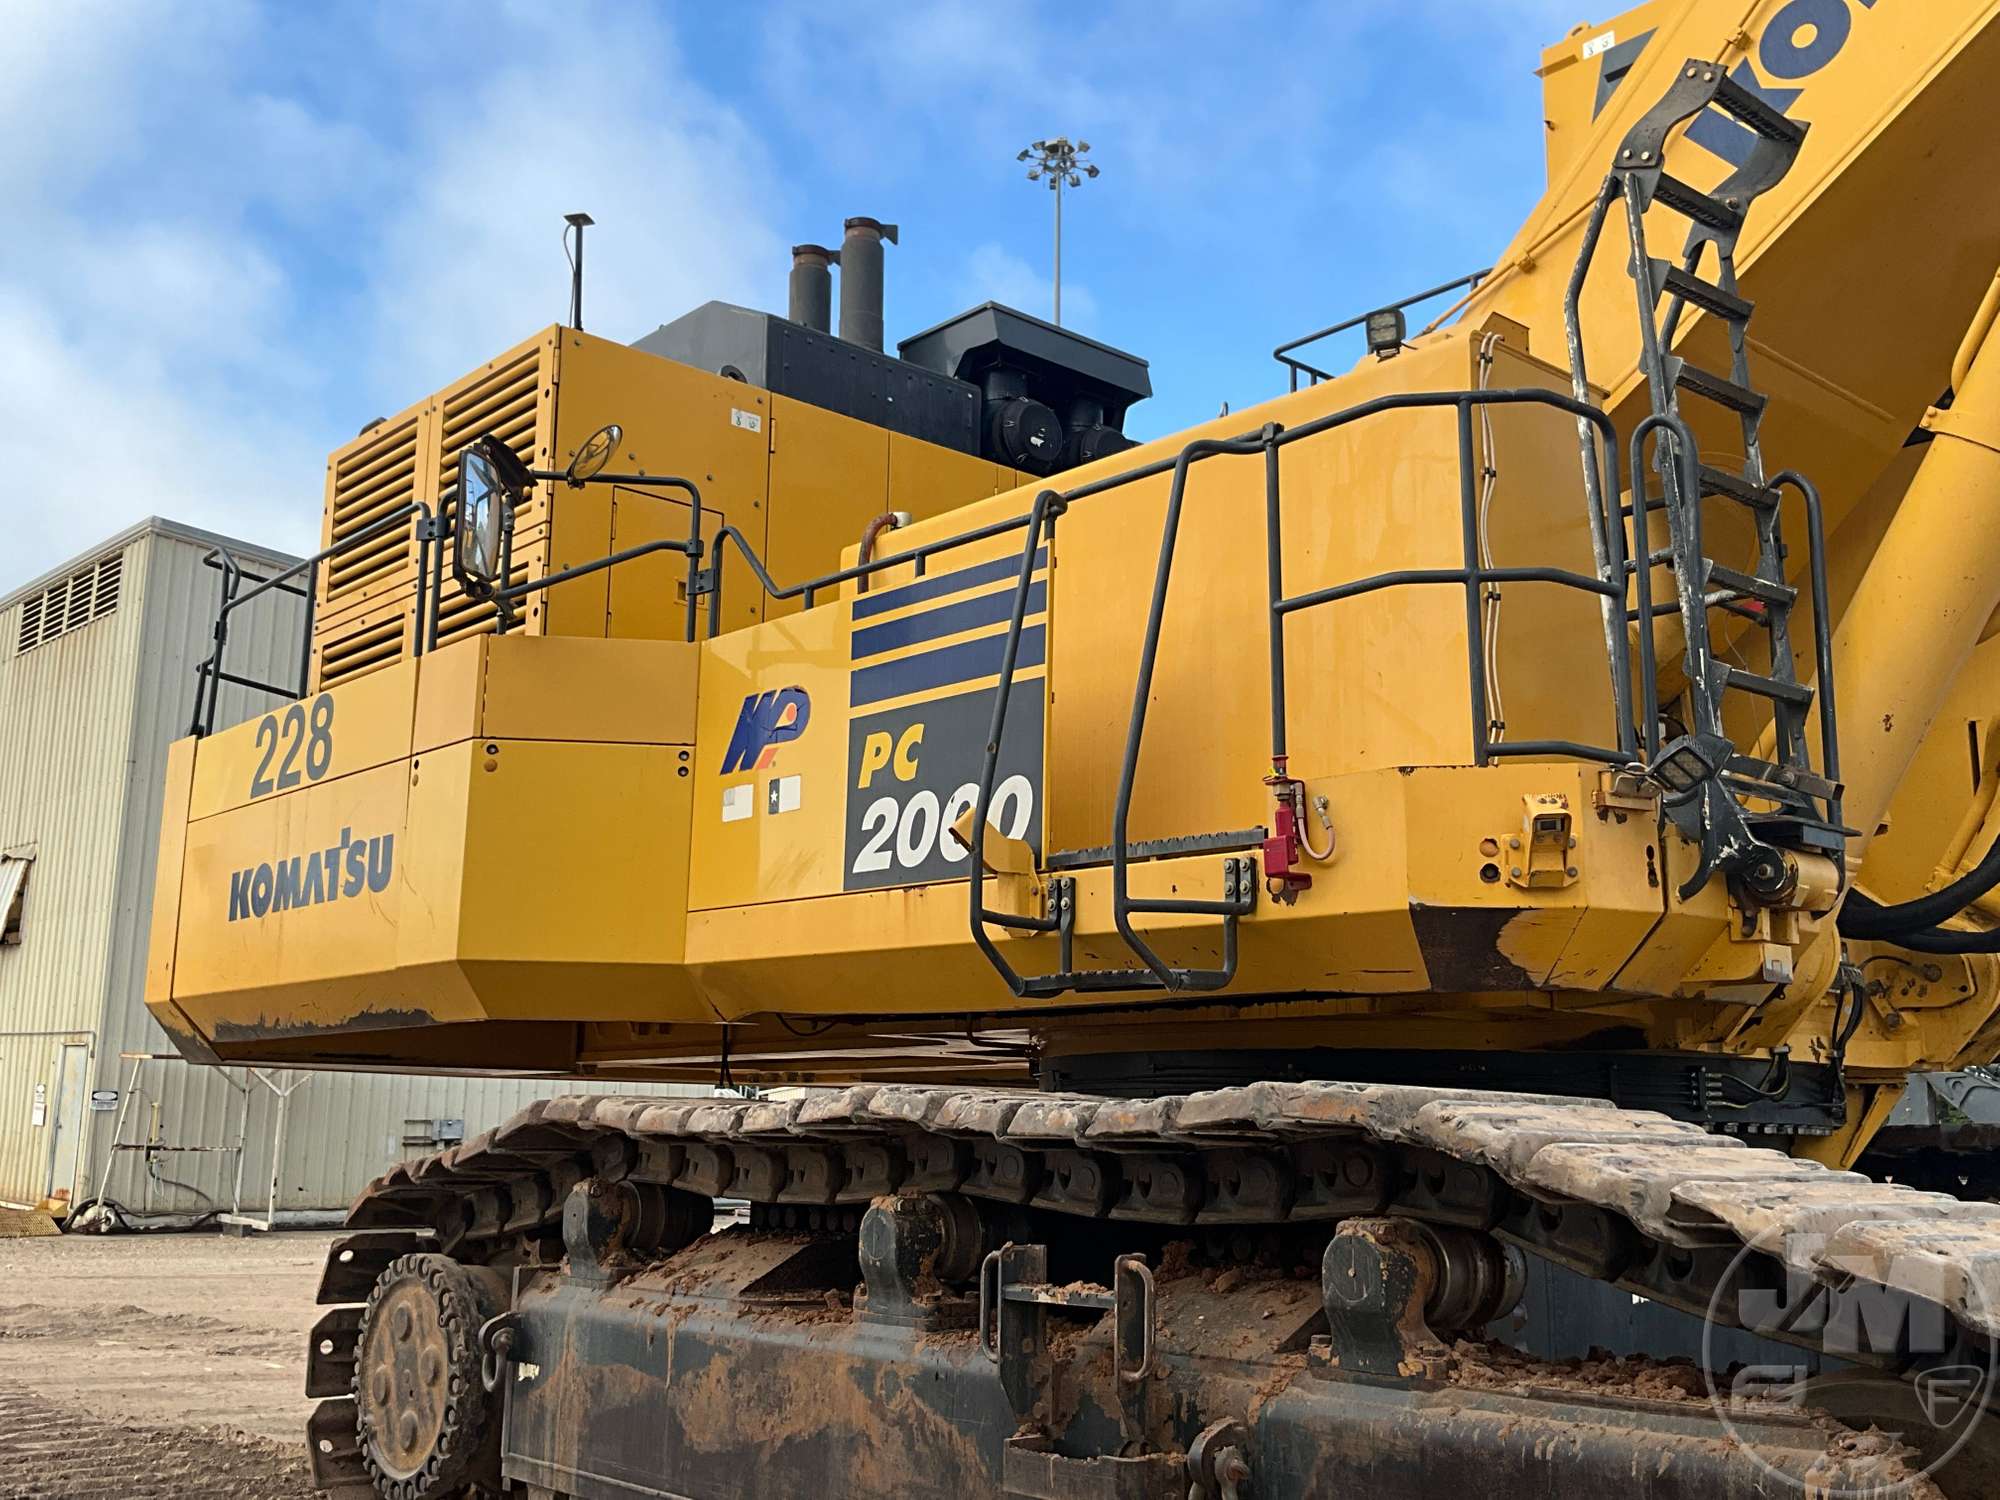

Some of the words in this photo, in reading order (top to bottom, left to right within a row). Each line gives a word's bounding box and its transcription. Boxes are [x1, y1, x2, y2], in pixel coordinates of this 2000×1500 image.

[1683, 0, 1877, 170] KO
[250, 693, 334, 799] 228
[858, 723, 925, 789] PC
[228, 826, 394, 922] KOMATSU
